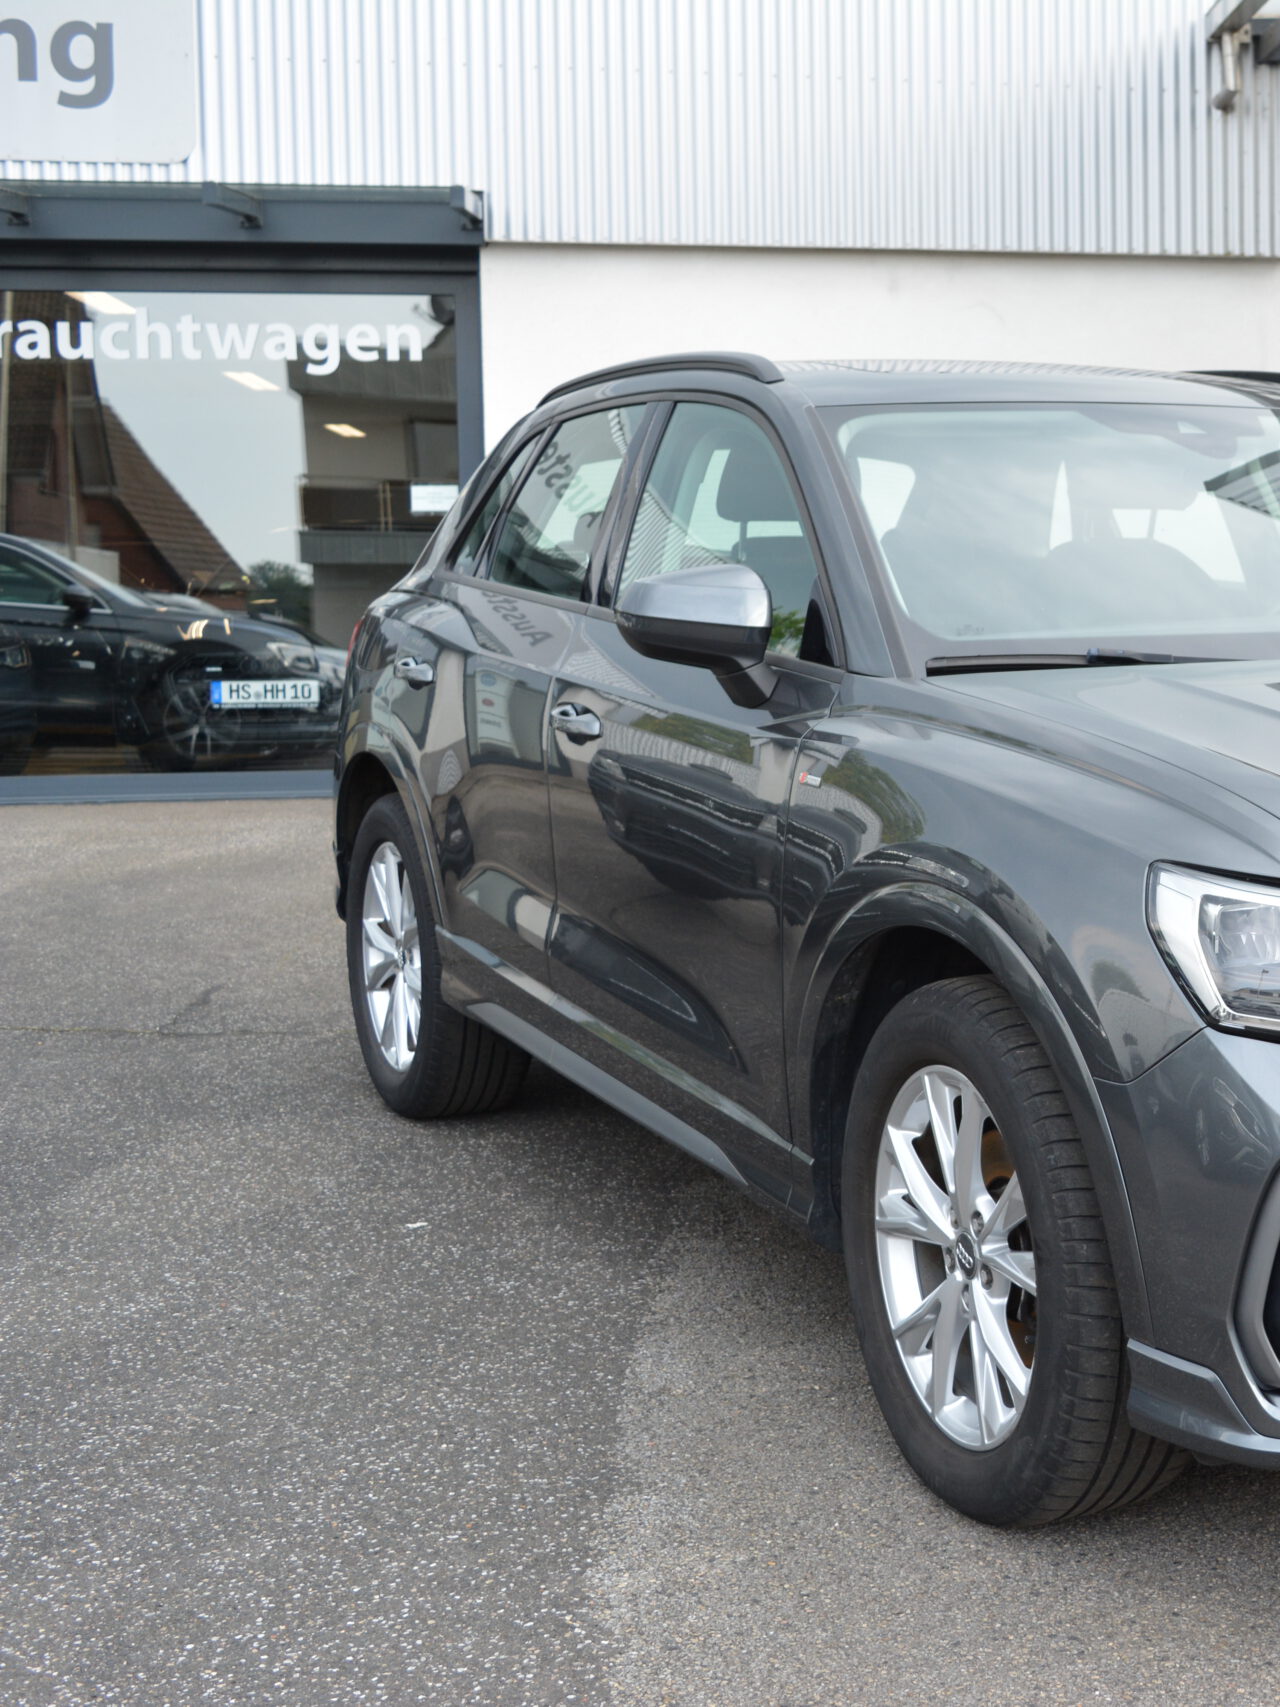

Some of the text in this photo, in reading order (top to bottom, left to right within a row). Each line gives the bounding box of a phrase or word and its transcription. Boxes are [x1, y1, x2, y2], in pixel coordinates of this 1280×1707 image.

[229, 683, 312, 700] HS HH 10
